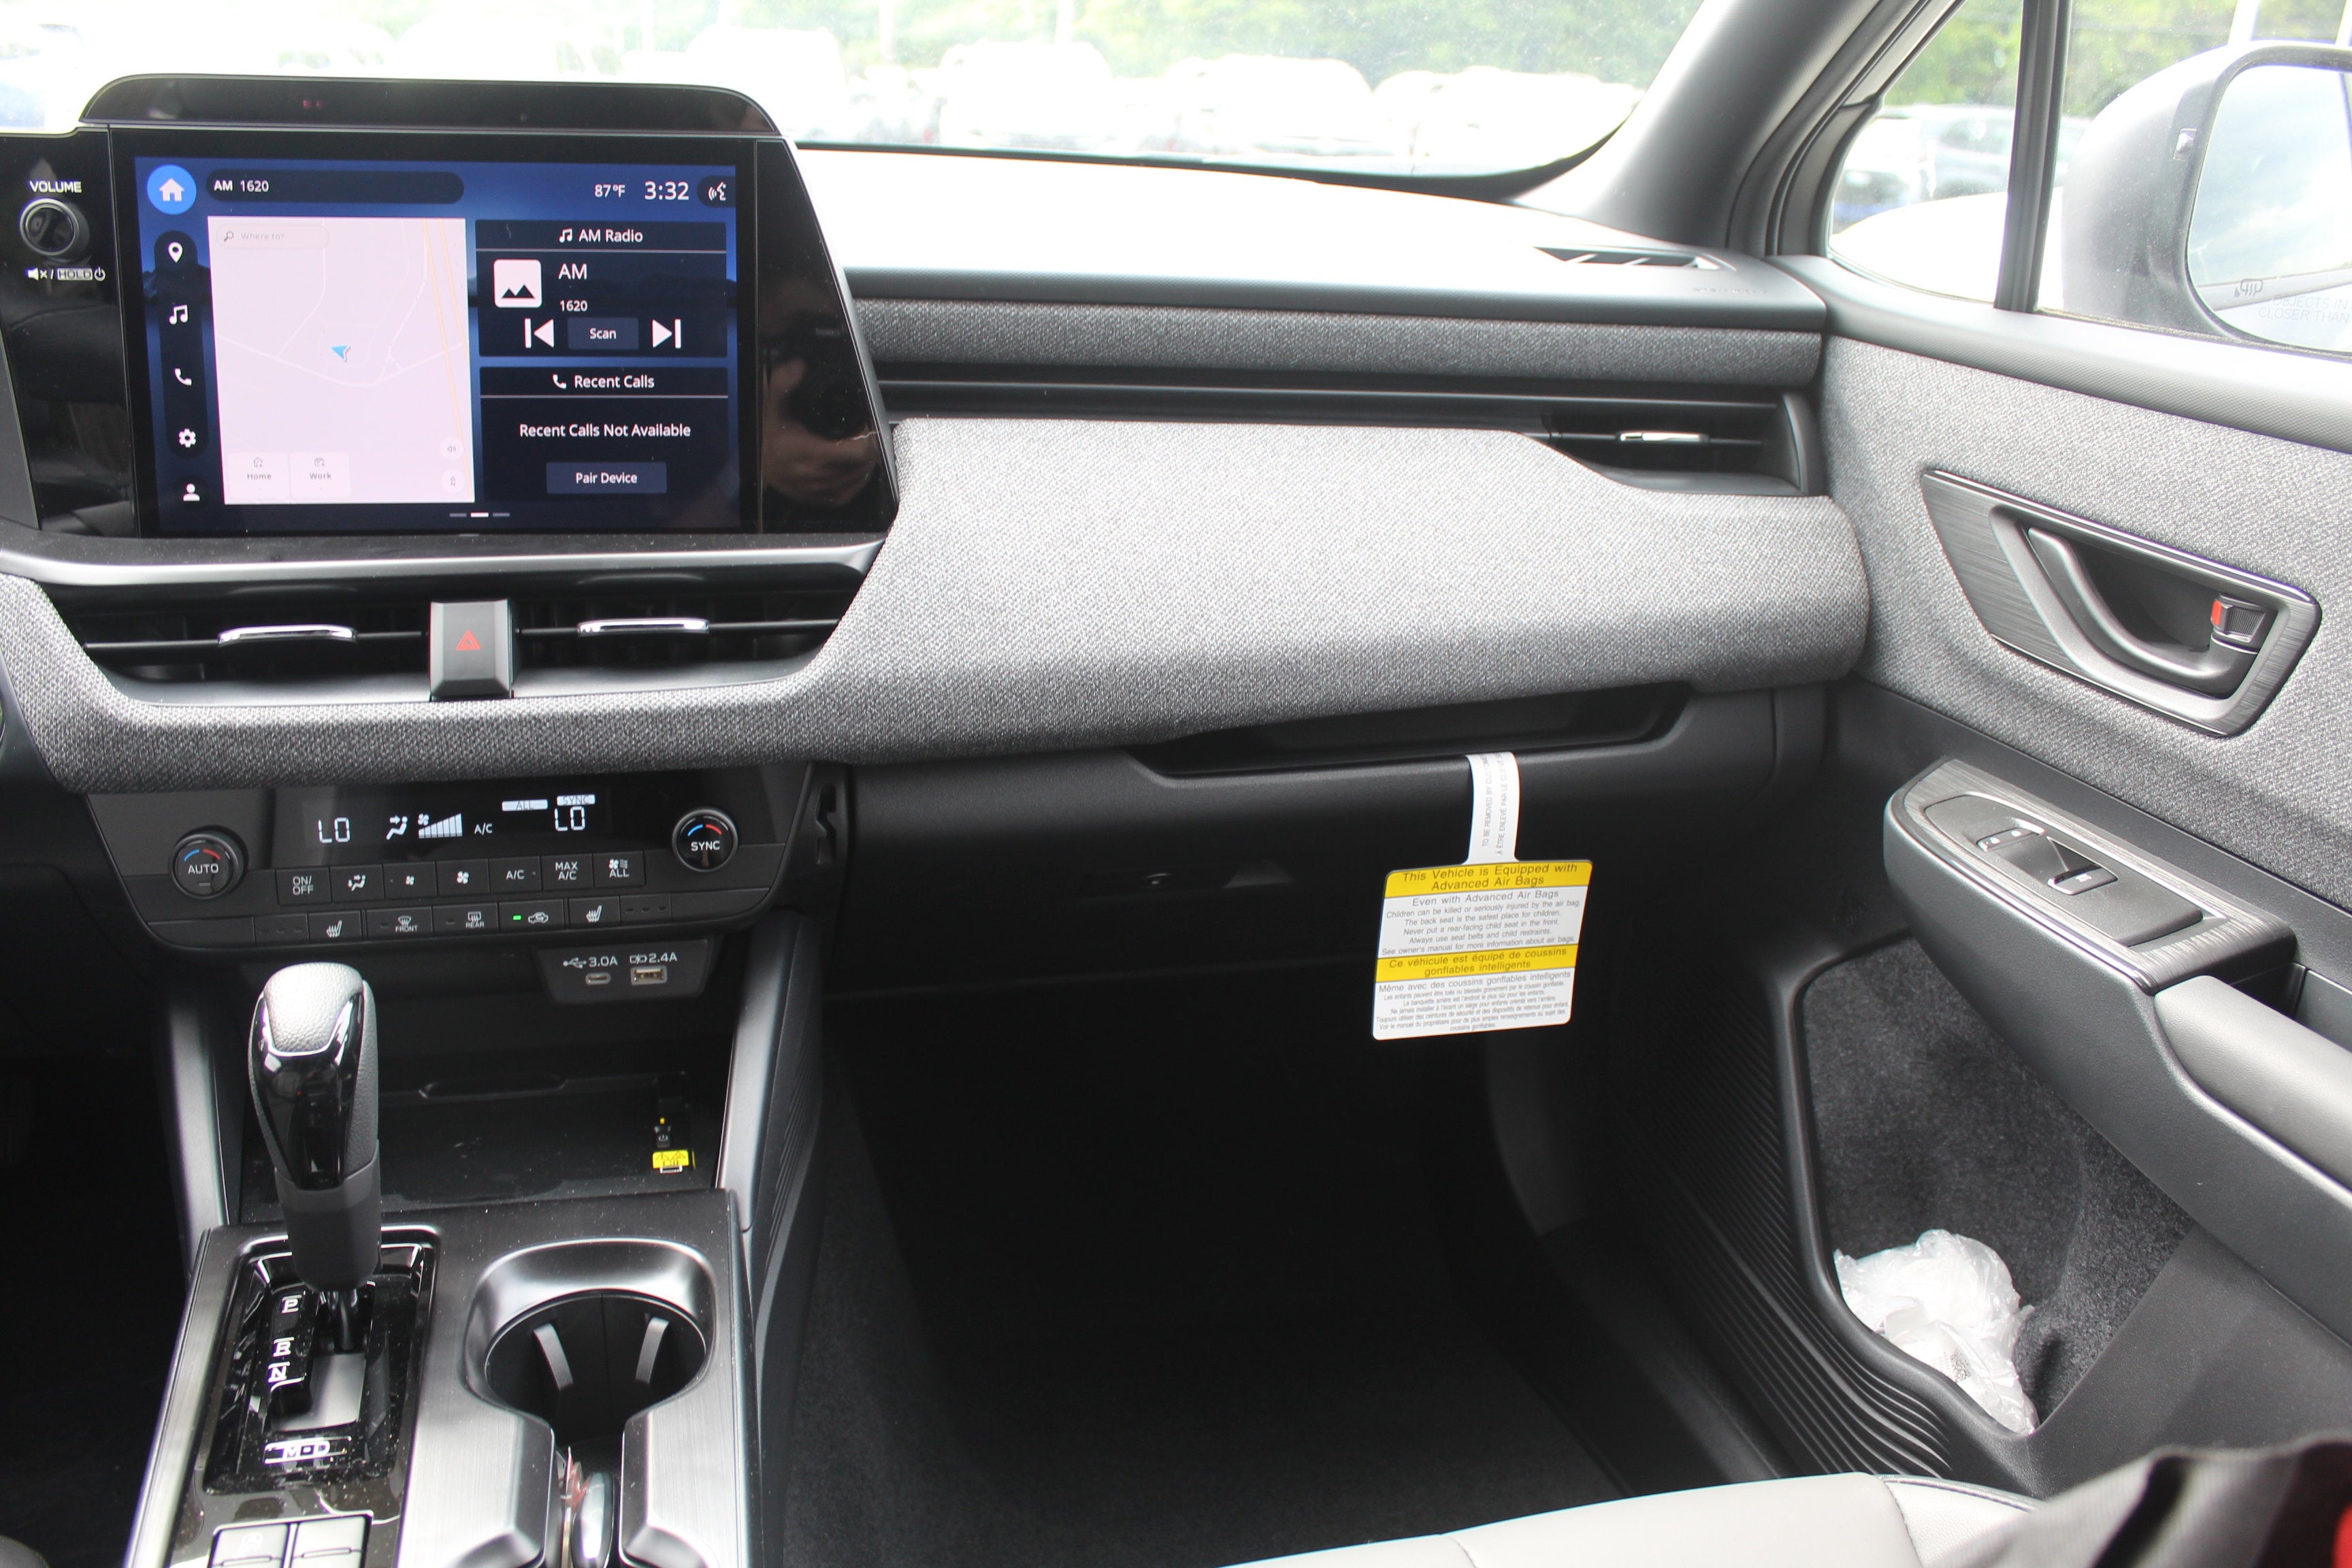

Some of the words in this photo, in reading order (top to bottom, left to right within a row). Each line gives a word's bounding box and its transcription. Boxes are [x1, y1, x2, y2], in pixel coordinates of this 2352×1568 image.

[30, 181, 82, 193] VOLUME
[214, 180, 233, 192] AM
[240, 180, 269, 193] 1620
[644, 182, 689, 200] 3:32
[578, 229, 600, 242] AM
[606, 229, 643, 242] Radio
[59, 269, 92, 280] HOLD
[559, 263, 587, 280] AM
[559, 300, 588, 312] 1620
[2273, 295, 2330, 309] OBJECTS
[2259, 307, 2310, 321] CLOSER
[589, 327, 617, 340] Scan
[574, 376, 619, 388] Recent
[624, 375, 655, 388] Calls
[520, 424, 566, 437] Recent
[569, 424, 600, 437] Calls
[604, 424, 627, 437] Not
[632, 424, 691, 437] Available
[247, 472, 272, 480] Home
[310, 471, 331, 480] Work
[576, 472, 598, 484] Pair
[600, 472, 638, 484] Device
[563, 795, 590, 805] SYNC
[474, 823, 493, 834] A/C
[691, 841, 720, 851] SYNC
[188, 863, 218, 875] AUTO
[555, 862, 578, 871] MAX
[1403, 872, 1426, 881] This
[1432, 867, 1474, 879] Vehicle
[1480, 866, 1488, 875] is
[1494, 864, 1549, 877] Equipped
[1554, 864, 1577, 872] with
[506, 870, 525, 881] A/C
[558, 870, 576, 881] A/C
[609, 868, 630, 878] ALL
[293, 876, 312, 885] ON/
[1432, 879, 1489, 891] Advanced
[1494, 877, 1509, 887] Air
[1516, 876, 1544, 888] Bags
[293, 885, 314, 895] OFF
[1412, 898, 1437, 906] Even
[1441, 895, 1460, 904] with
[1464, 891, 1513, 902] Advanced
[1516, 890, 1531, 898] Air
[1535, 889, 1558, 898] Bags
[1386, 910, 1415, 918] Children
[1443, 906, 1462, 914] killed
[1473, 903, 1503, 912] seriously
[1505, 902, 1529, 911] injured
[1531, 901, 1539, 909] by
[466, 921, 485, 929] REAR
[1404, 918, 1418, 926] The
[1420, 917, 1436, 925] back
[1477, 913, 1499, 921] safest
[1500, 912, 1519, 920] place
[395, 924, 418, 933] FRONT
[1426, 926, 1437, 934] put
[1447, 924, 1483, 932] rear-facing
[1485, 921, 1501, 930] child
[1427, 943, 1452, 951] manual
[1486, 939, 1523, 947] information
[589, 956, 618, 968] 3.0A
[649, 953, 678, 964] 2.4A
[1388, 958, 1403, 968] Ce
[1407, 956, 1448, 966] véhicule
[1452, 954, 1467, 963] est
[1471, 951, 1505, 962] équipé
[1508, 951, 1520, 959] de
[1524, 947, 1567, 958] coussins
[1424, 964, 1474, 977] gonflables
[1479, 960, 1531, 971] intelligents
[1379, 984, 1404, 992] Même
[1430, 981, 1445, 989] des
[1448, 978, 1483, 987] coussins
[1486, 974, 1526, 985] gonflables
[1529, 970, 1571, 980] intelligents
